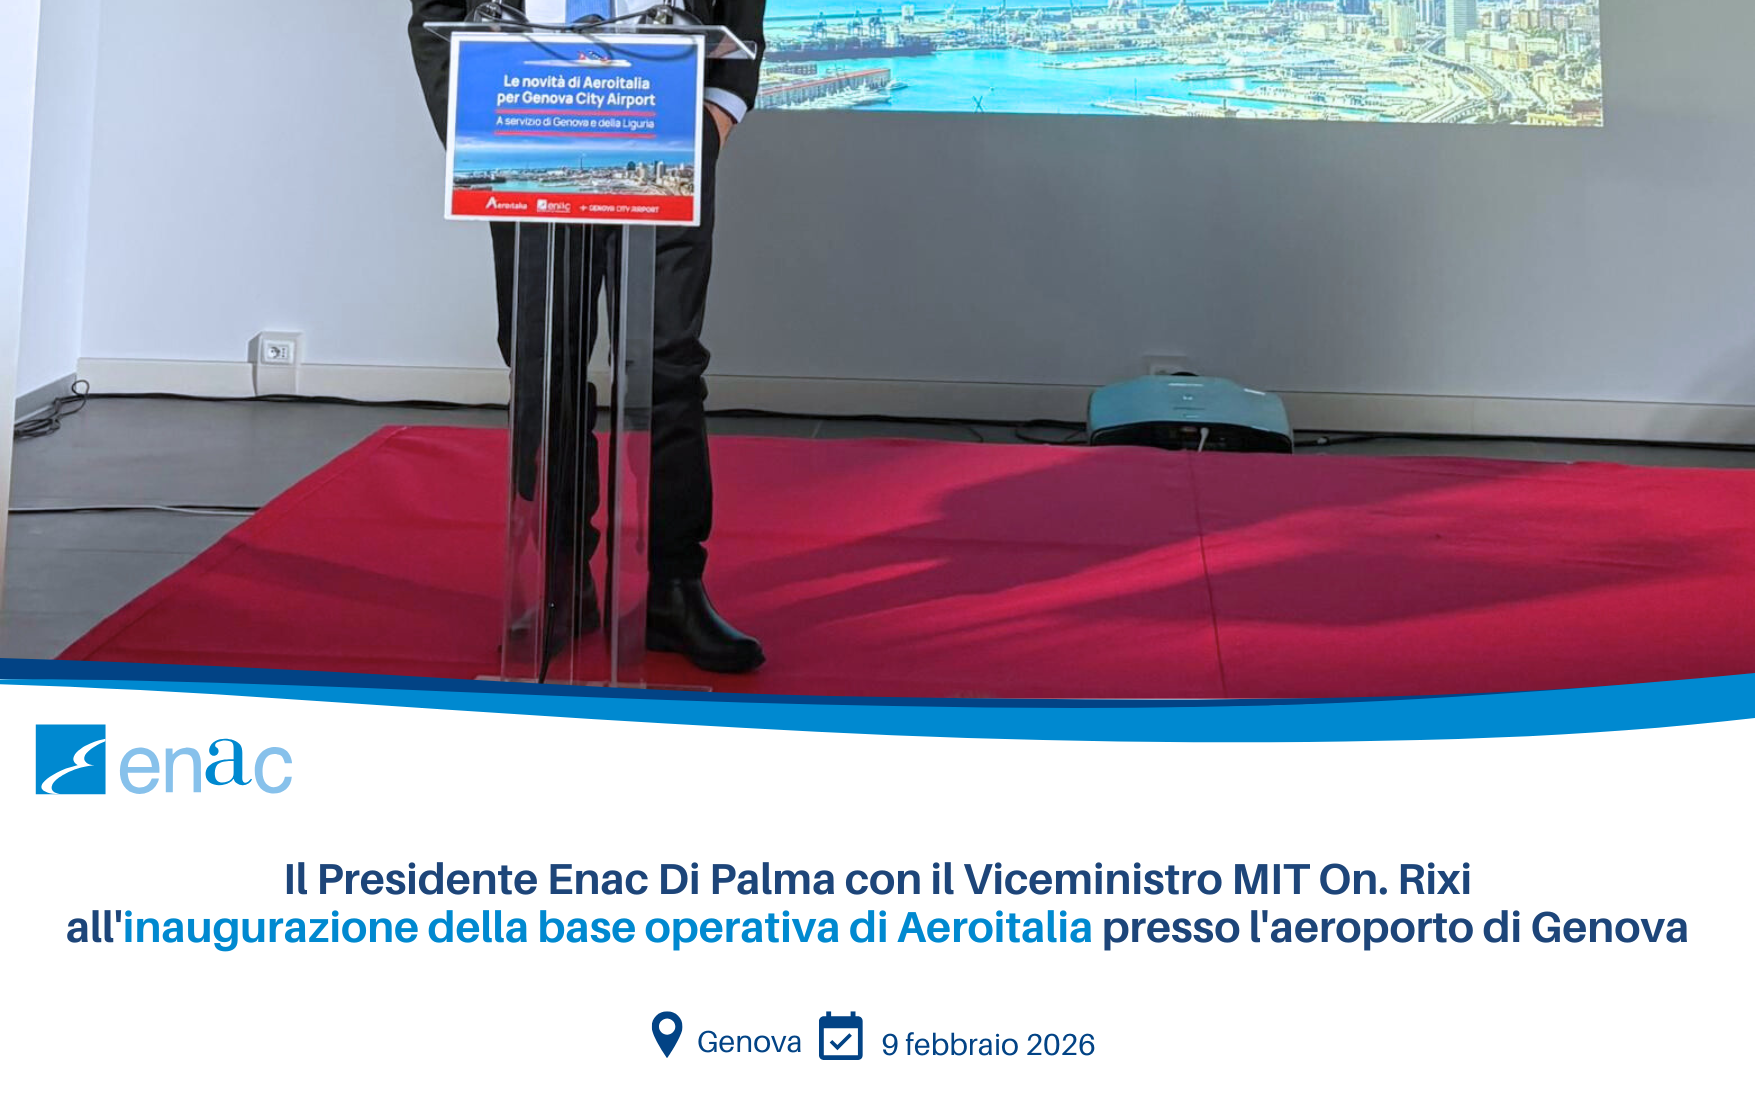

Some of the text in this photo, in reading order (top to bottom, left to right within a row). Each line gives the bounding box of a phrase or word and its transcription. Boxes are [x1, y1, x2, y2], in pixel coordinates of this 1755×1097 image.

[503, 74, 651, 90] Le novità di Aeroitalia
[497, 91, 656, 109] per Genova City Airport
[496, 116, 655, 131] A servizio di Genova e della Liguria
[616, 205, 630, 213] CITY
